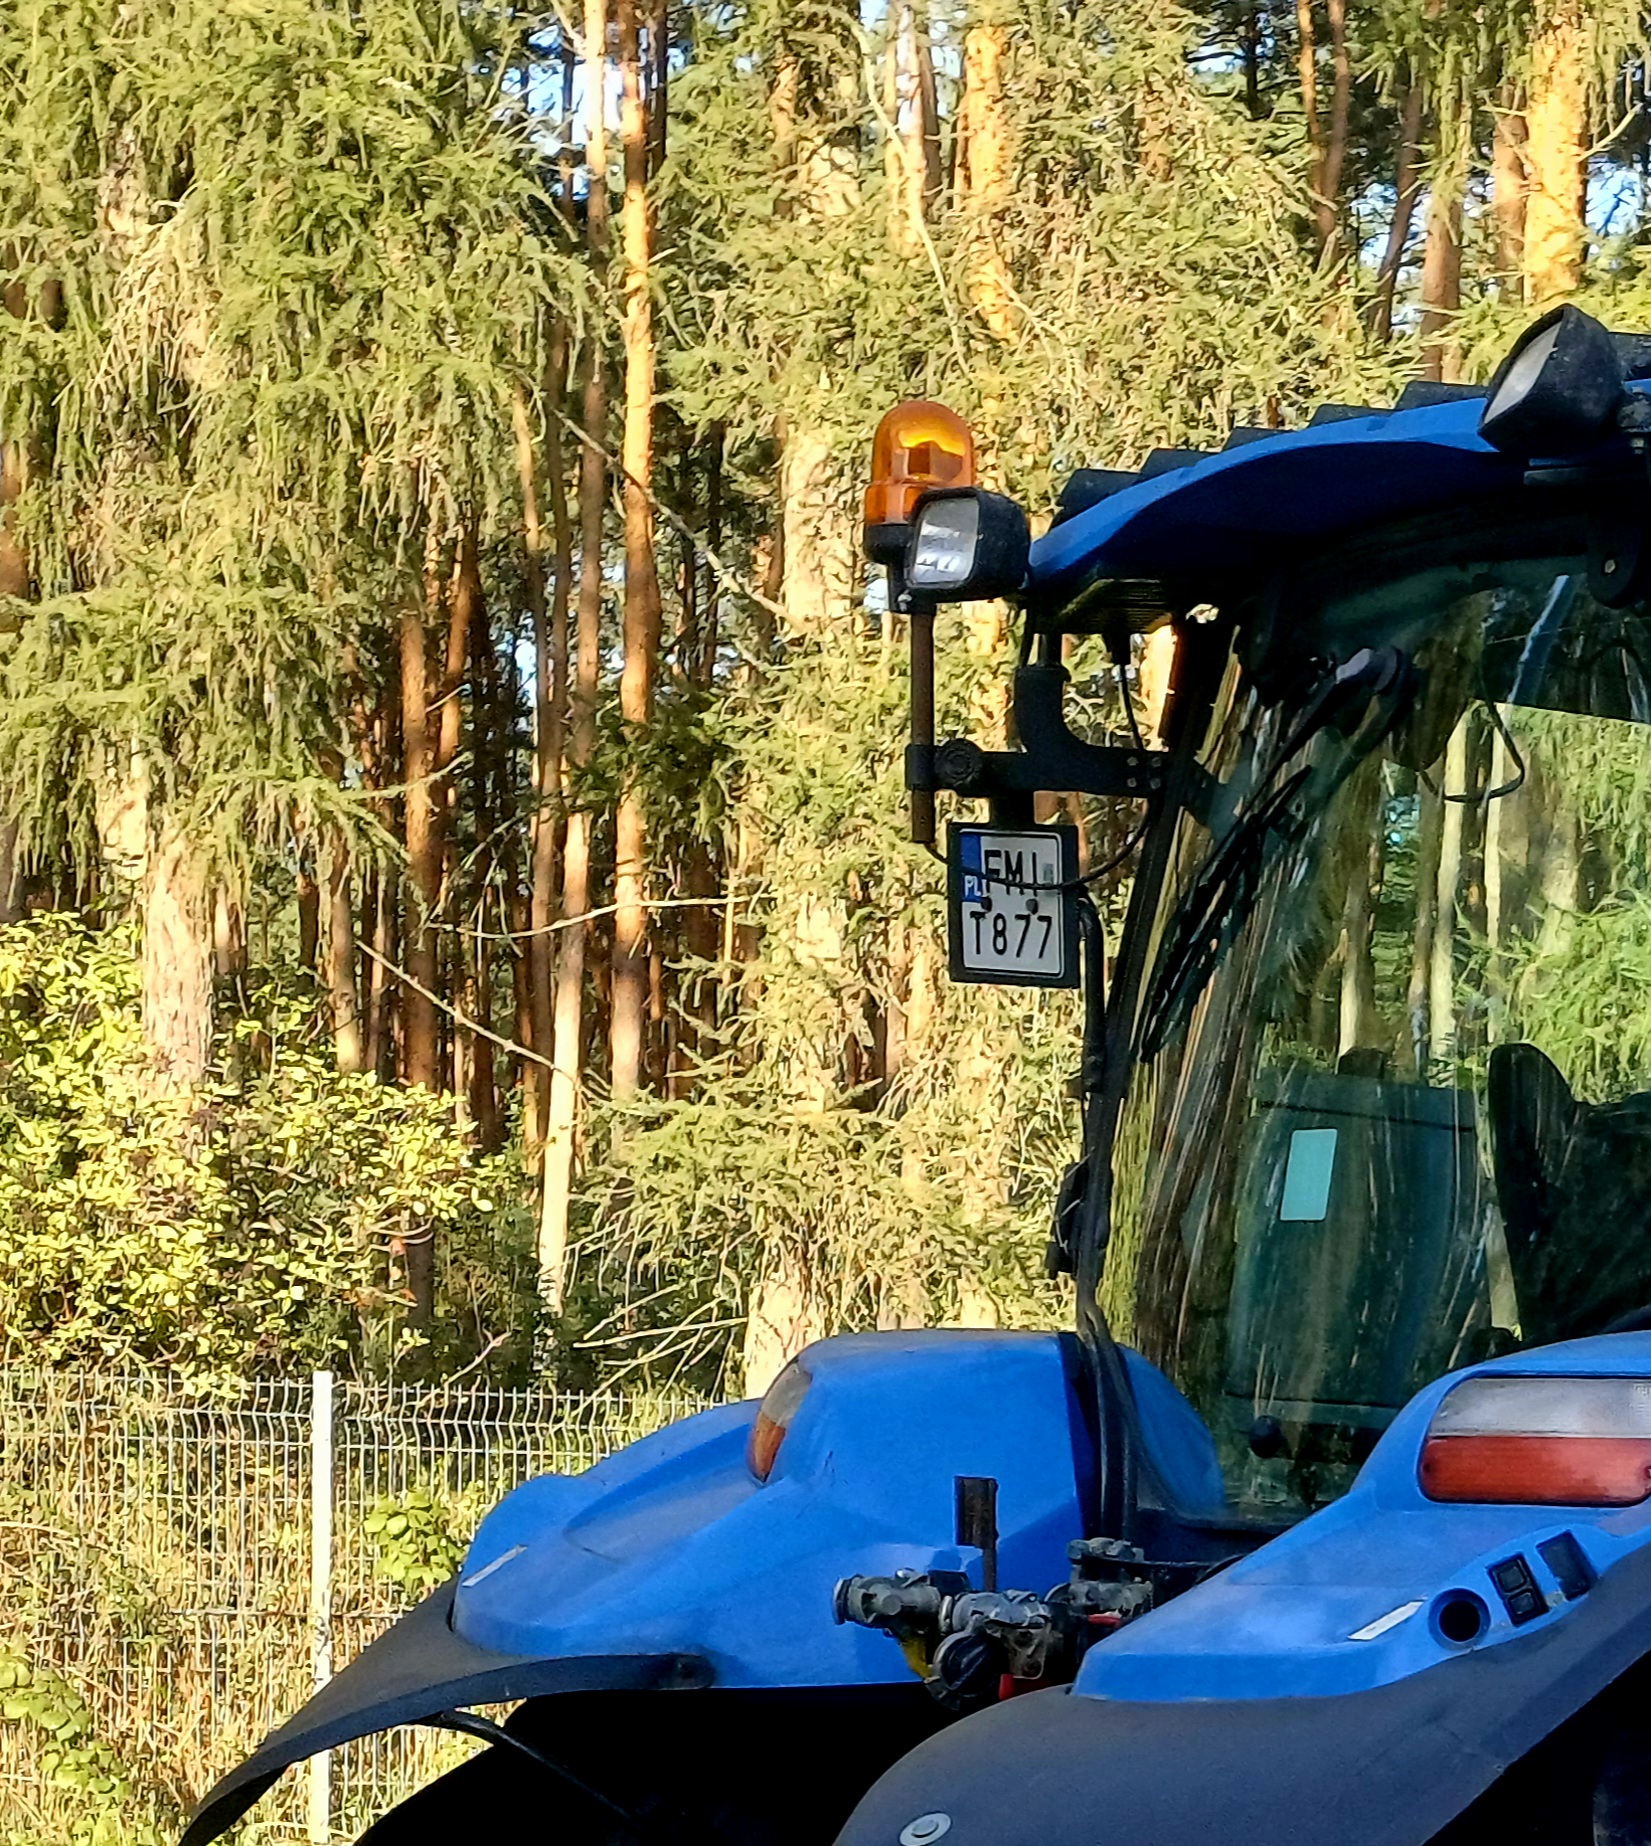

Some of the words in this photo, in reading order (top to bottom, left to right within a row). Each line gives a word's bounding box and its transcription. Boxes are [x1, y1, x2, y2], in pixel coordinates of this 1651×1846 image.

[964, 875, 982, 896] PL
[984, 849, 1038, 897] FMI
[969, 910, 1053, 959] T877
